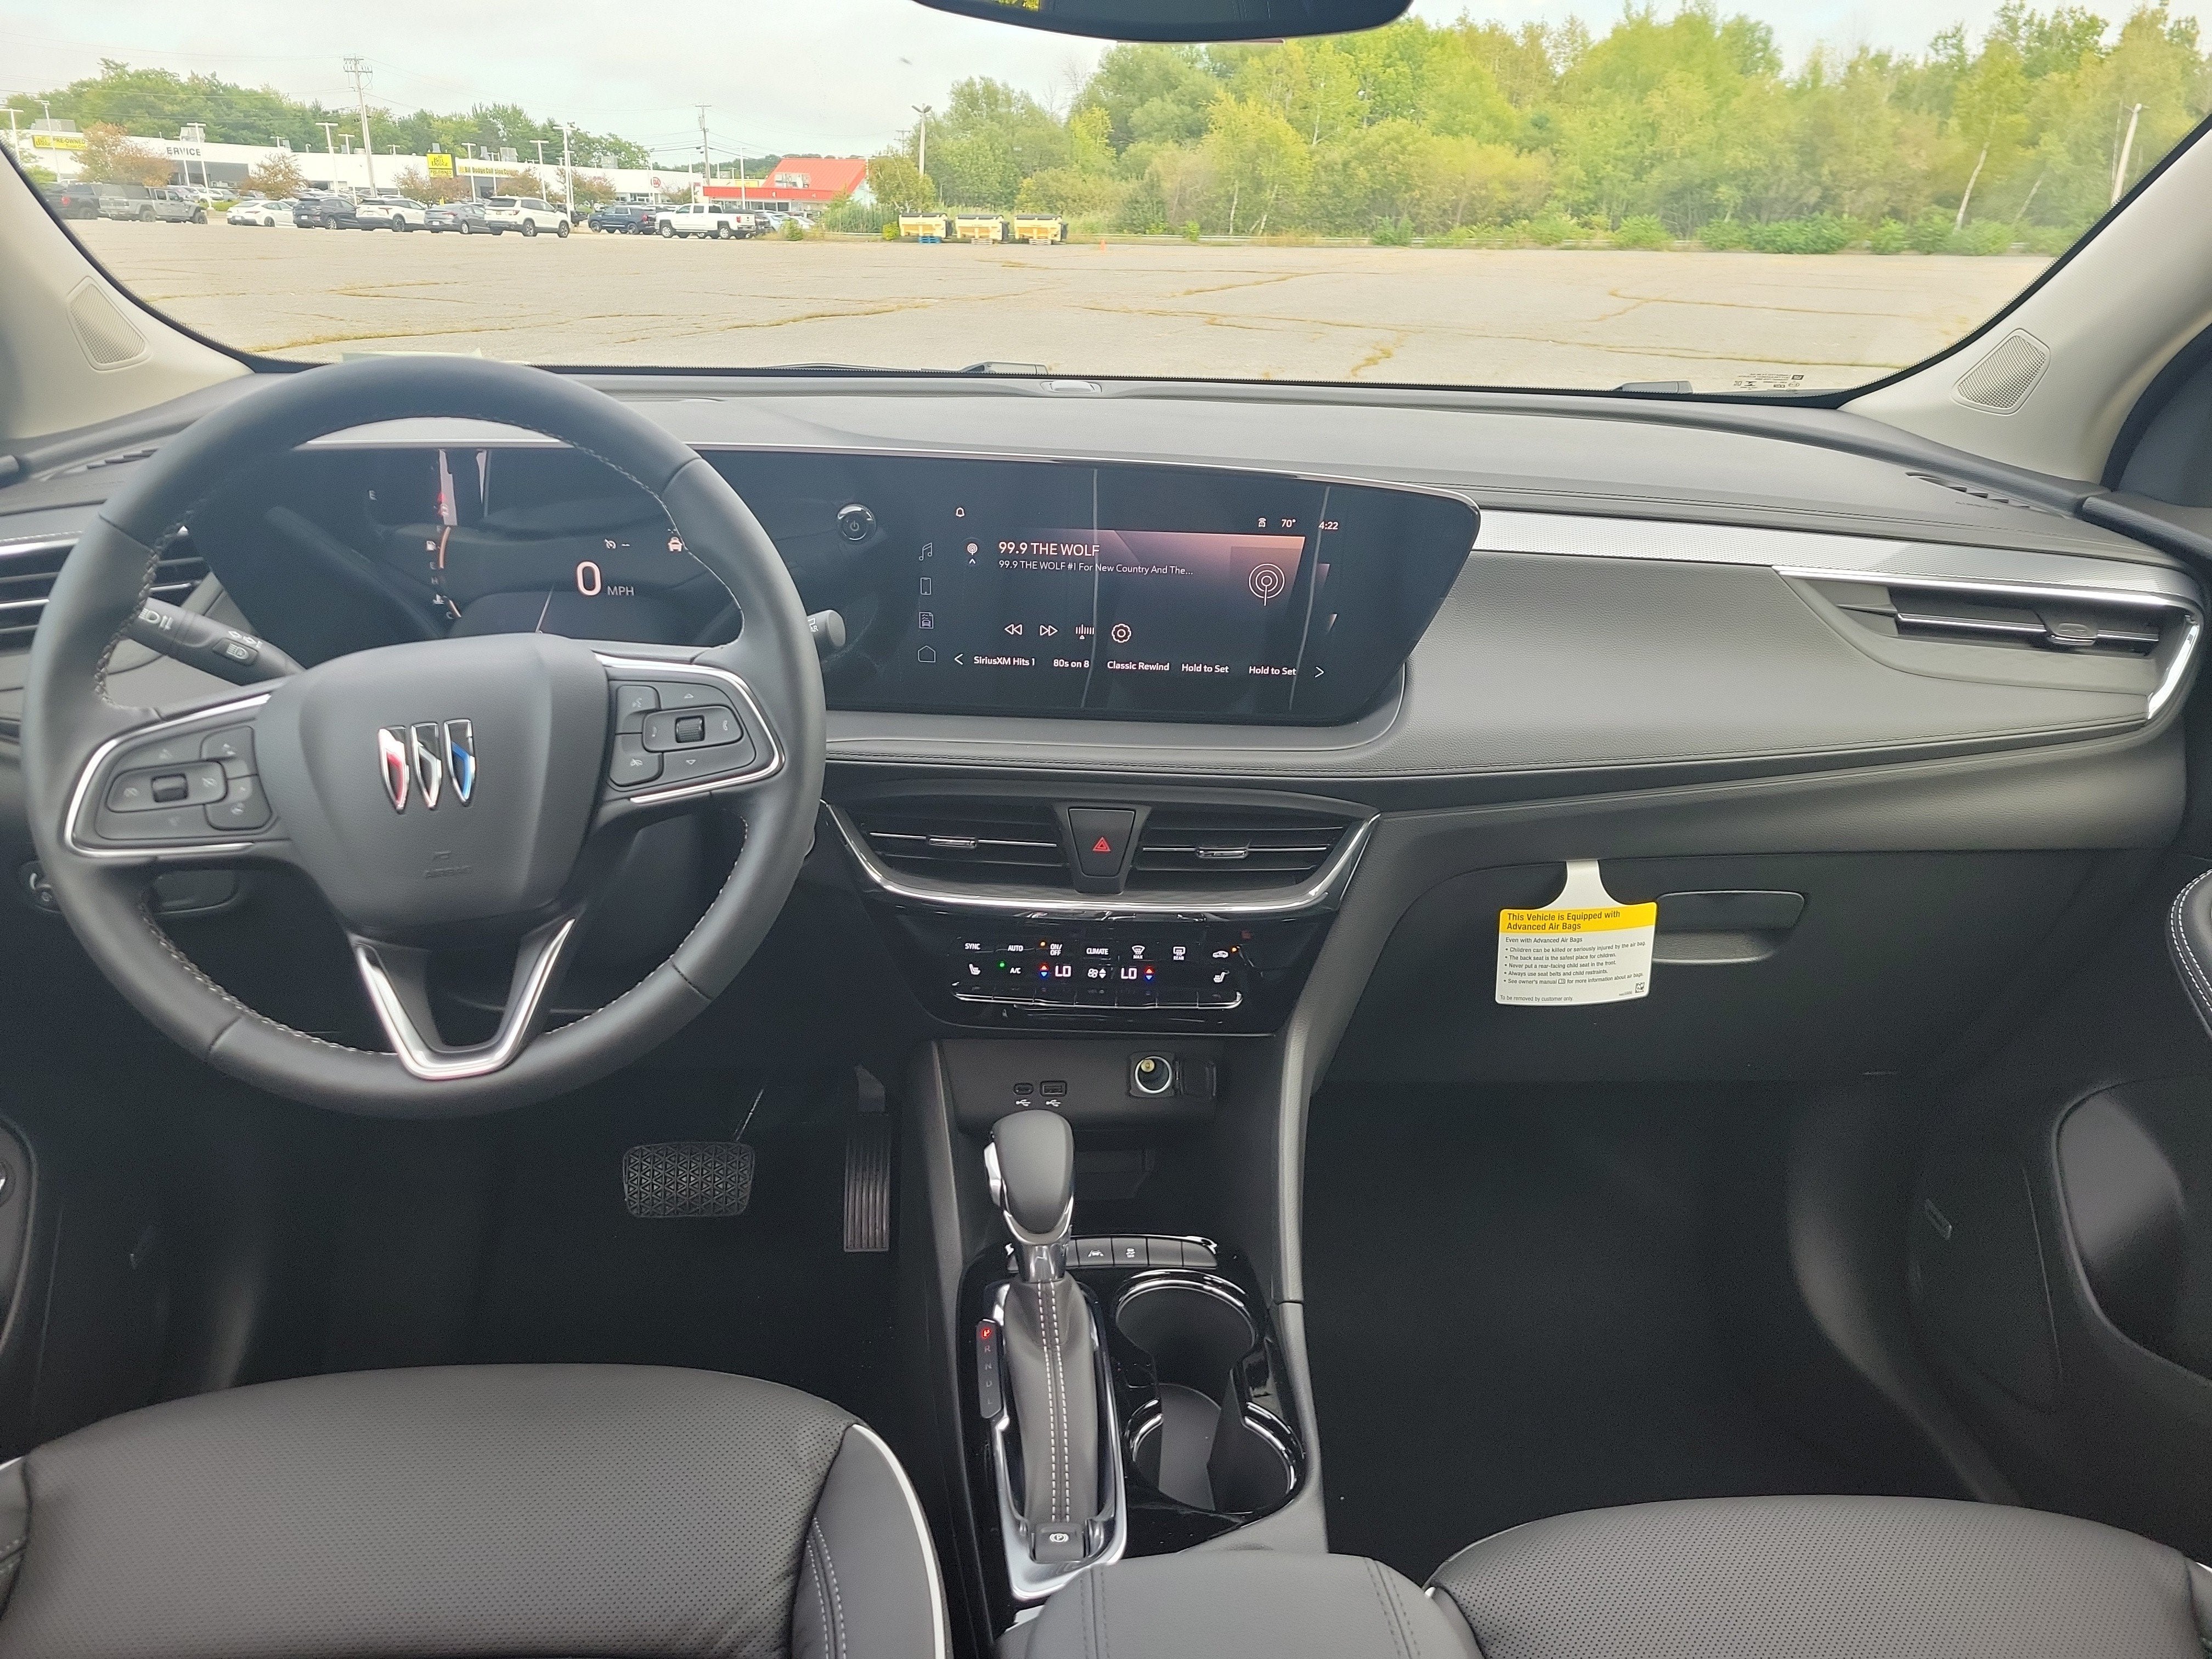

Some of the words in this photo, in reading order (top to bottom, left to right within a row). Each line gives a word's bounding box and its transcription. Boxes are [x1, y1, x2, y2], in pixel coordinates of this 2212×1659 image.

[166, 147, 201, 156] ERVICE
[1318, 521, 1339, 530] 4:22
[998, 541, 1028, 554] 99.9
[1030, 543, 1058, 555] THE
[1060, 544, 1100, 557] WOLF
[998, 560, 1018, 569] 99.9
[1019, 560, 1038, 569] THE
[1039, 561, 1066, 570] WOLF
[1067, 562, 1076, 571] #1
[1079, 562, 1093, 571] For
[1094, 563, 1114, 572] New
[1116, 564, 1150, 575] Country
[1150, 565, 1167, 574] And
[1169, 566, 1193, 575] The...
[577, 561, 601, 596] 0
[607, 585, 635, 596] MPH
[974, 656, 1011, 665] SiriusXM
[1013, 657, 1030, 666] Hits
[1031, 658, 1035, 666] 1
[1053, 659, 1069, 667] 80s
[1107, 661, 1137, 670] Classic
[1138, 662, 1170, 671] Rewind
[1182, 663, 1202, 672] Hold
[1214, 665, 1229, 673] Set
[1249, 666, 1269, 675] Hold
[1567, 911, 1602, 922] Equipped
[1604, 910, 1620, 918] with
[1506, 922, 1546, 930] Advanced
[1548, 922, 1560, 930] Air
[1562, 922, 1581, 931] Bags
[1055, 965, 1071, 977] LO
[1121, 967, 1137, 980] LO
[983, 1329, 991, 1337] P
[984, 1345, 991, 1353] R
[985, 1361, 992, 1370] N
